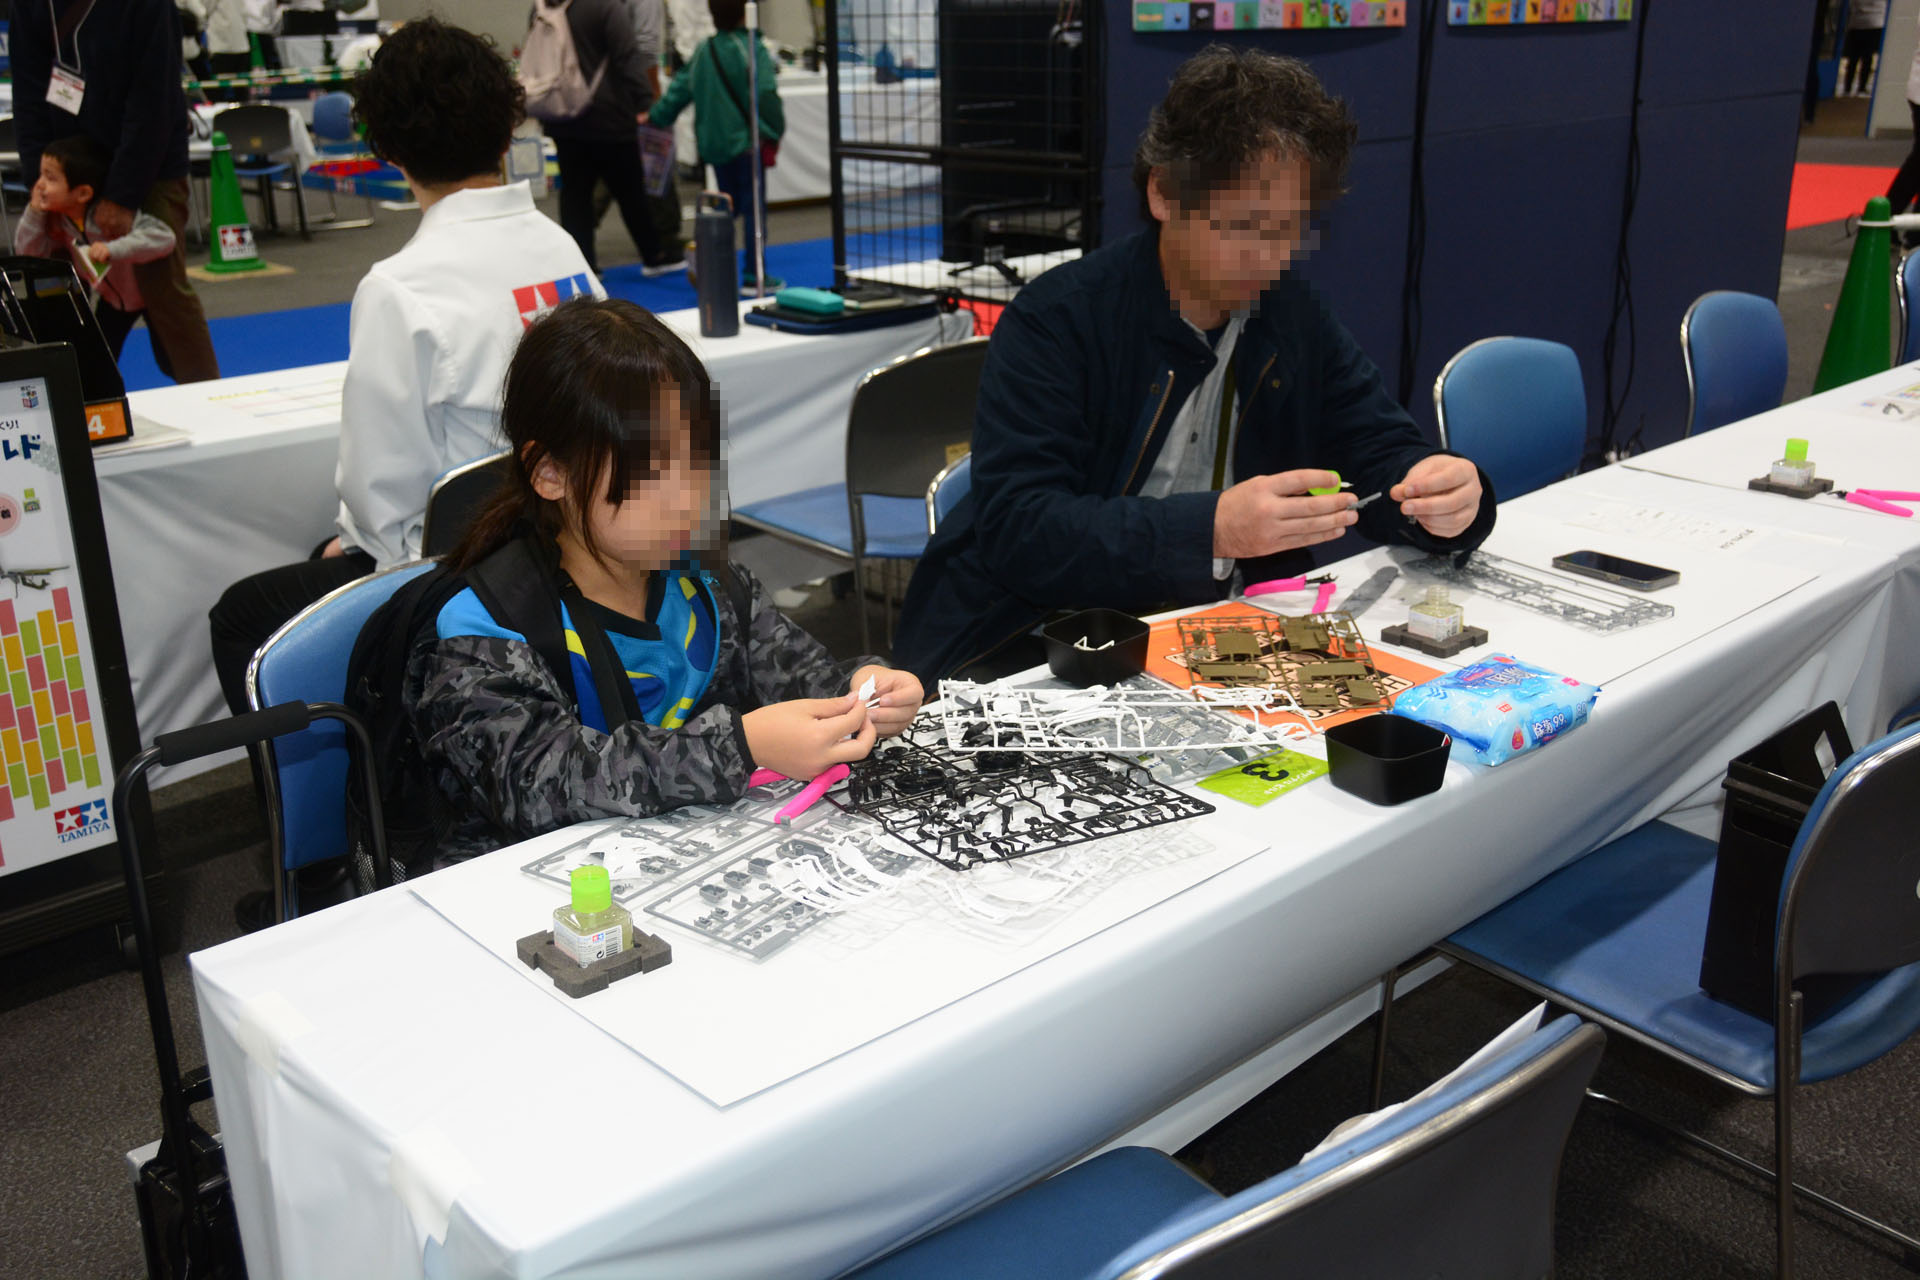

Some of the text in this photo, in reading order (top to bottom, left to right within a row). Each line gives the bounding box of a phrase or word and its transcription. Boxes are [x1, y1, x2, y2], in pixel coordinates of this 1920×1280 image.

[88, 413, 106, 435] 4
[1241, 763, 1290, 782] 3
[57, 821, 111, 844] TAMIYA
